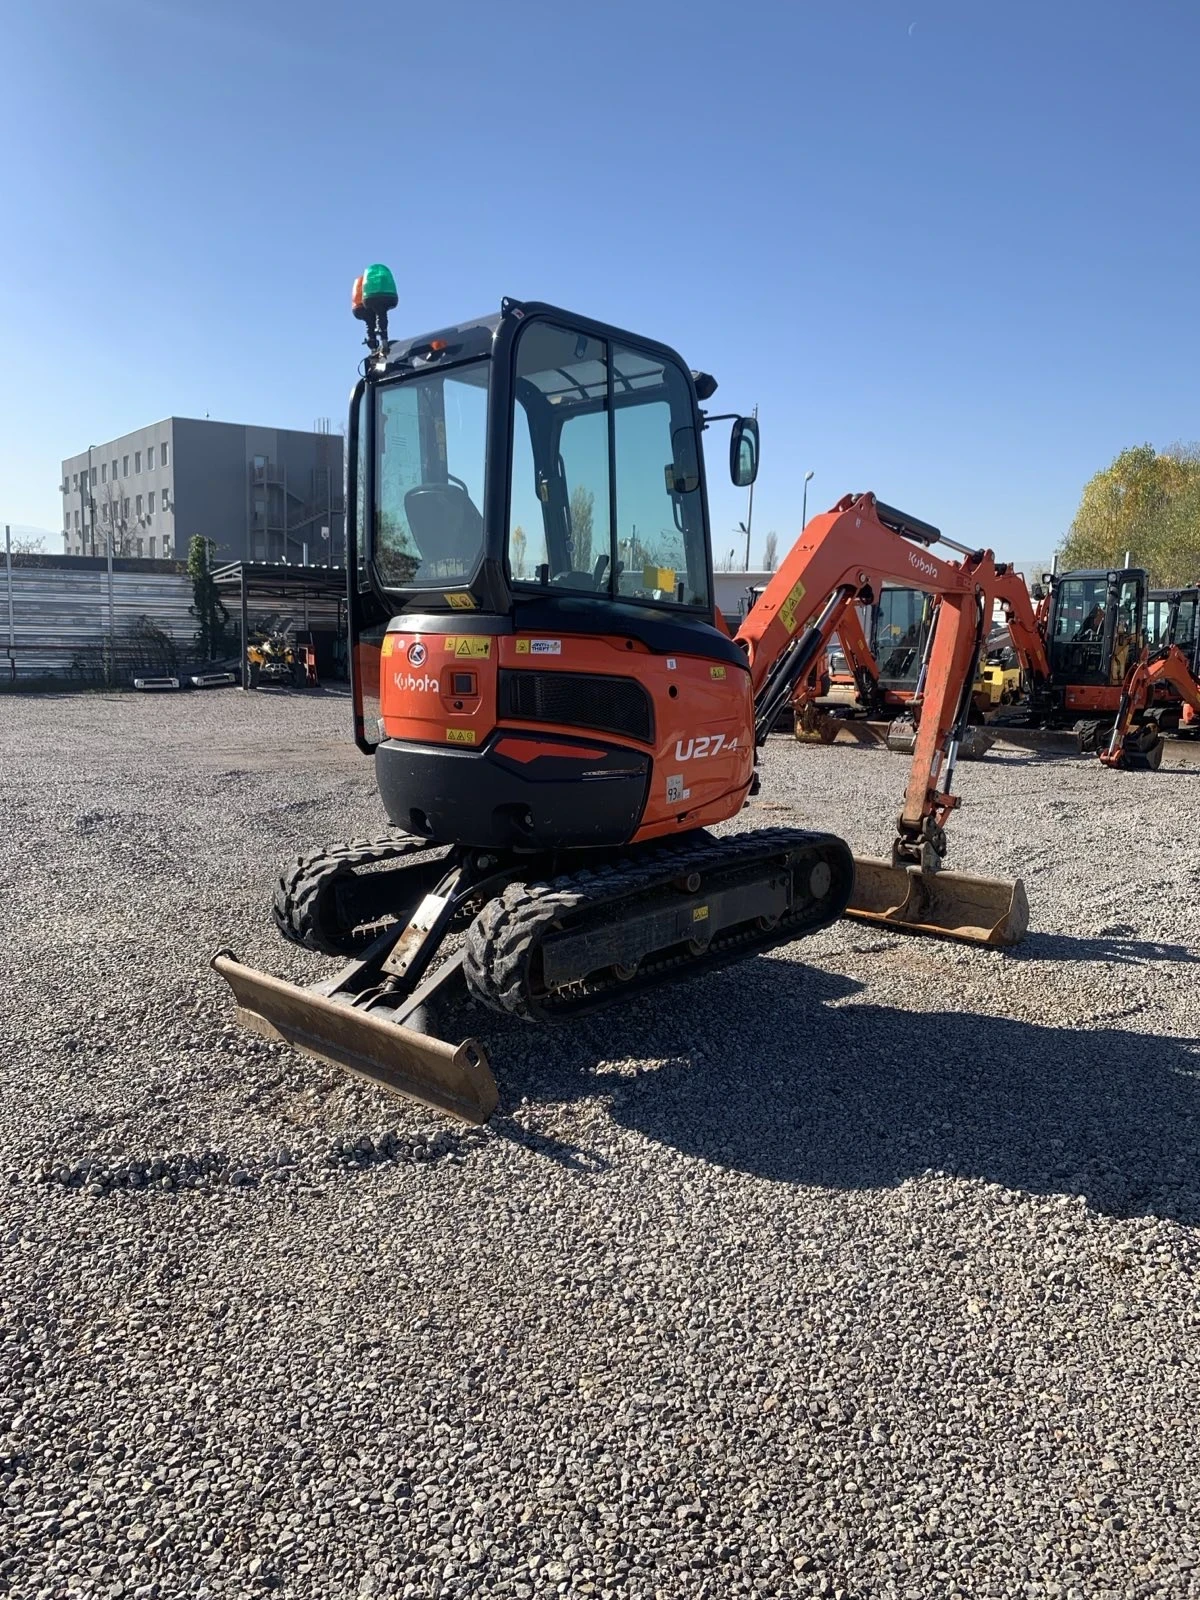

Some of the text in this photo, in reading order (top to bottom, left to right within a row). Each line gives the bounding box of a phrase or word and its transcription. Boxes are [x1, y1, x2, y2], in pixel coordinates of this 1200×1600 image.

[908, 551, 938, 578] Kubota
[393, 672, 439, 693] Kubota
[675, 734, 738, 761] U27-4
